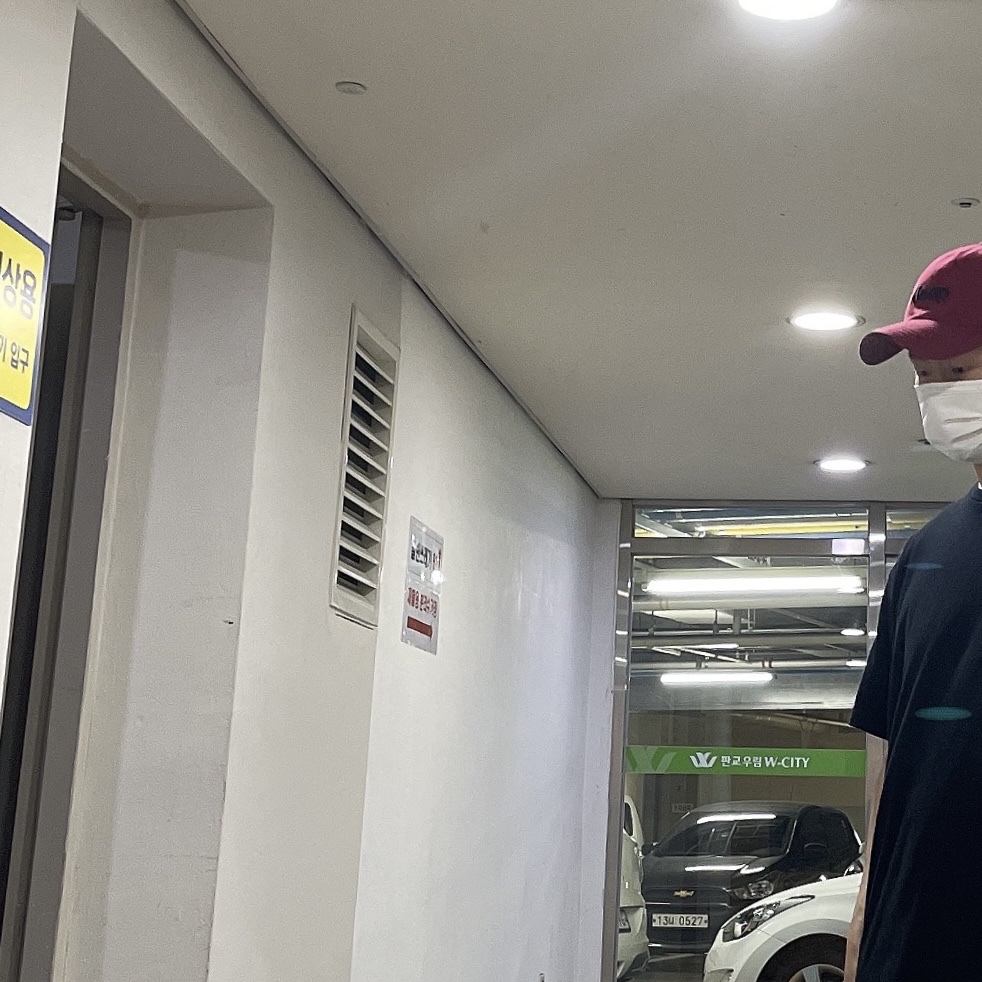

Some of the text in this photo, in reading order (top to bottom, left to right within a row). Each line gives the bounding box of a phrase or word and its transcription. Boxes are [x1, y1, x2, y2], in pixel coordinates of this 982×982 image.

[0, 251, 36, 319] 상용
[10, 342, 30, 373] 입구
[721, 755, 762, 768] 판교우림
[764, 756, 810, 768] W-CITY
[679, 915, 704, 926] 0527
